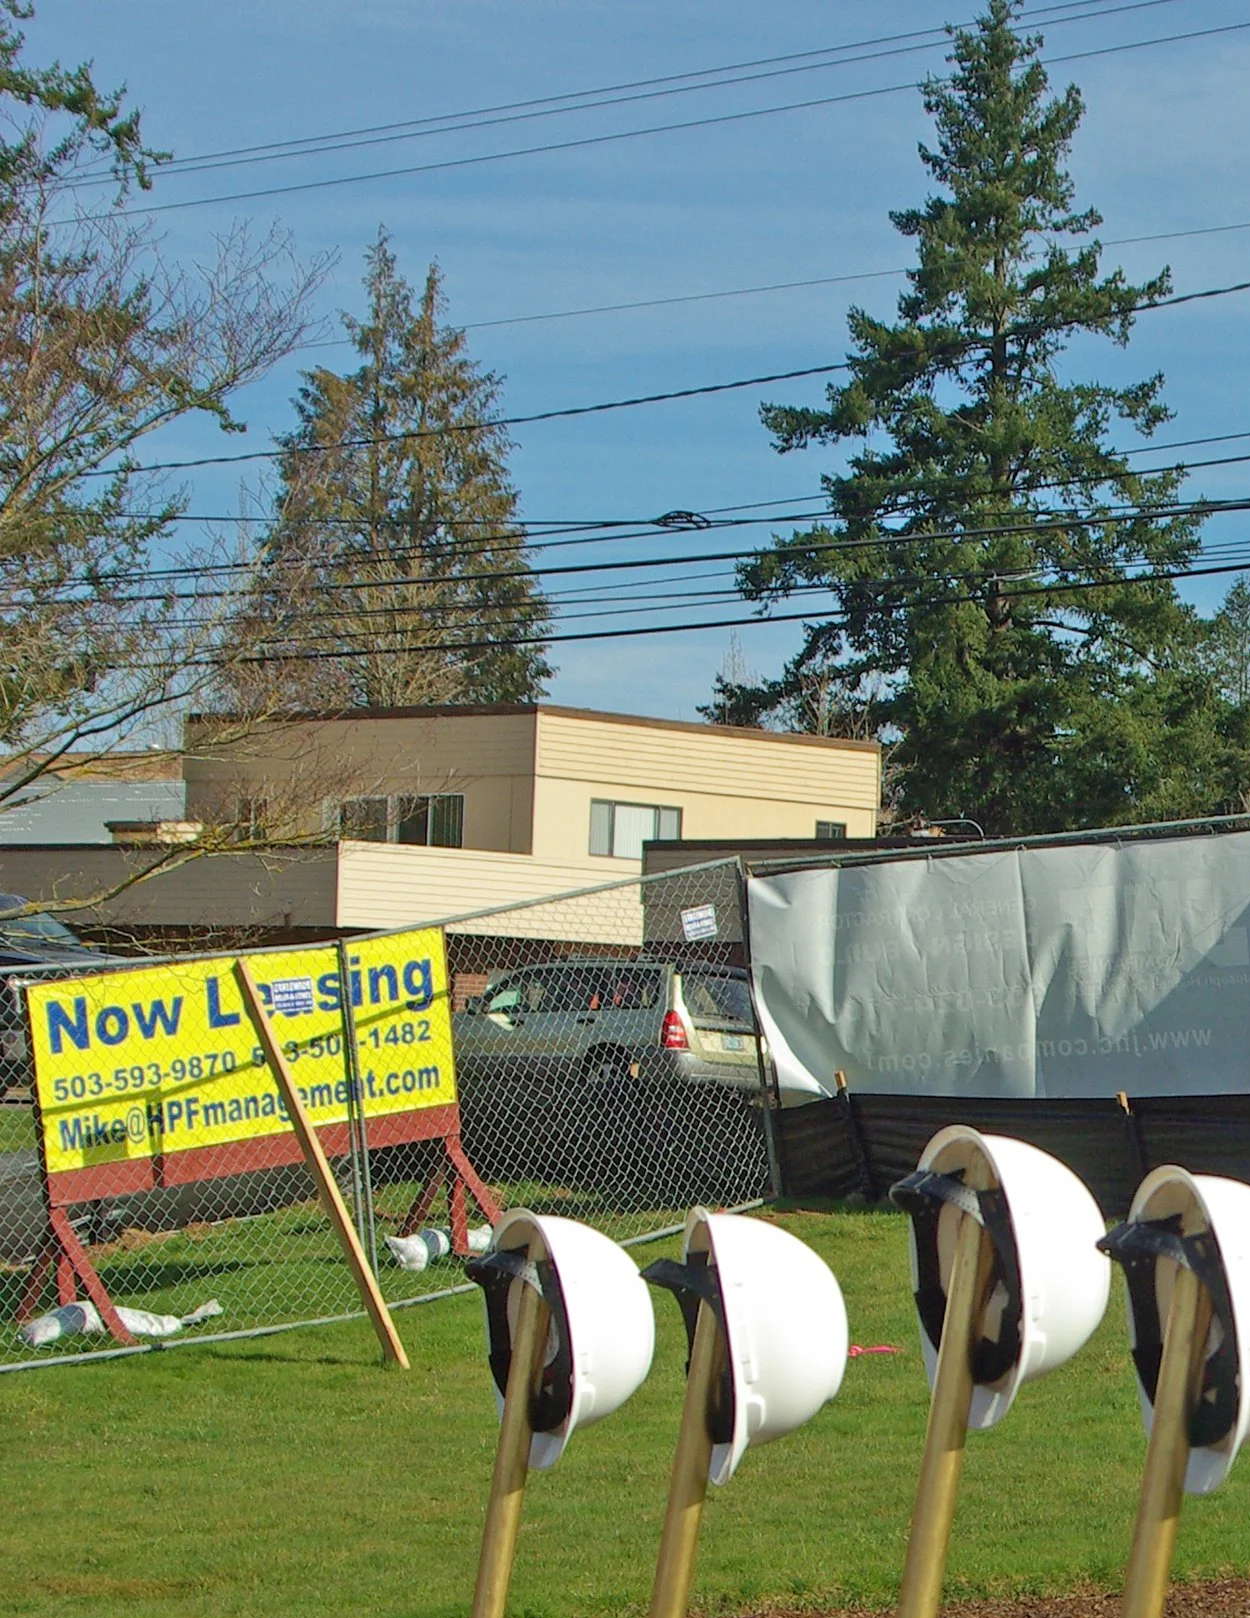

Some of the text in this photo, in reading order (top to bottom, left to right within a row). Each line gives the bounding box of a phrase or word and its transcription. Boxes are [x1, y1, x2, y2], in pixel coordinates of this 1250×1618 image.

[46, 956, 433, 1055] Now Lsing
[54, 1020, 431, 1102] 503-593-9870 53-50-1482
